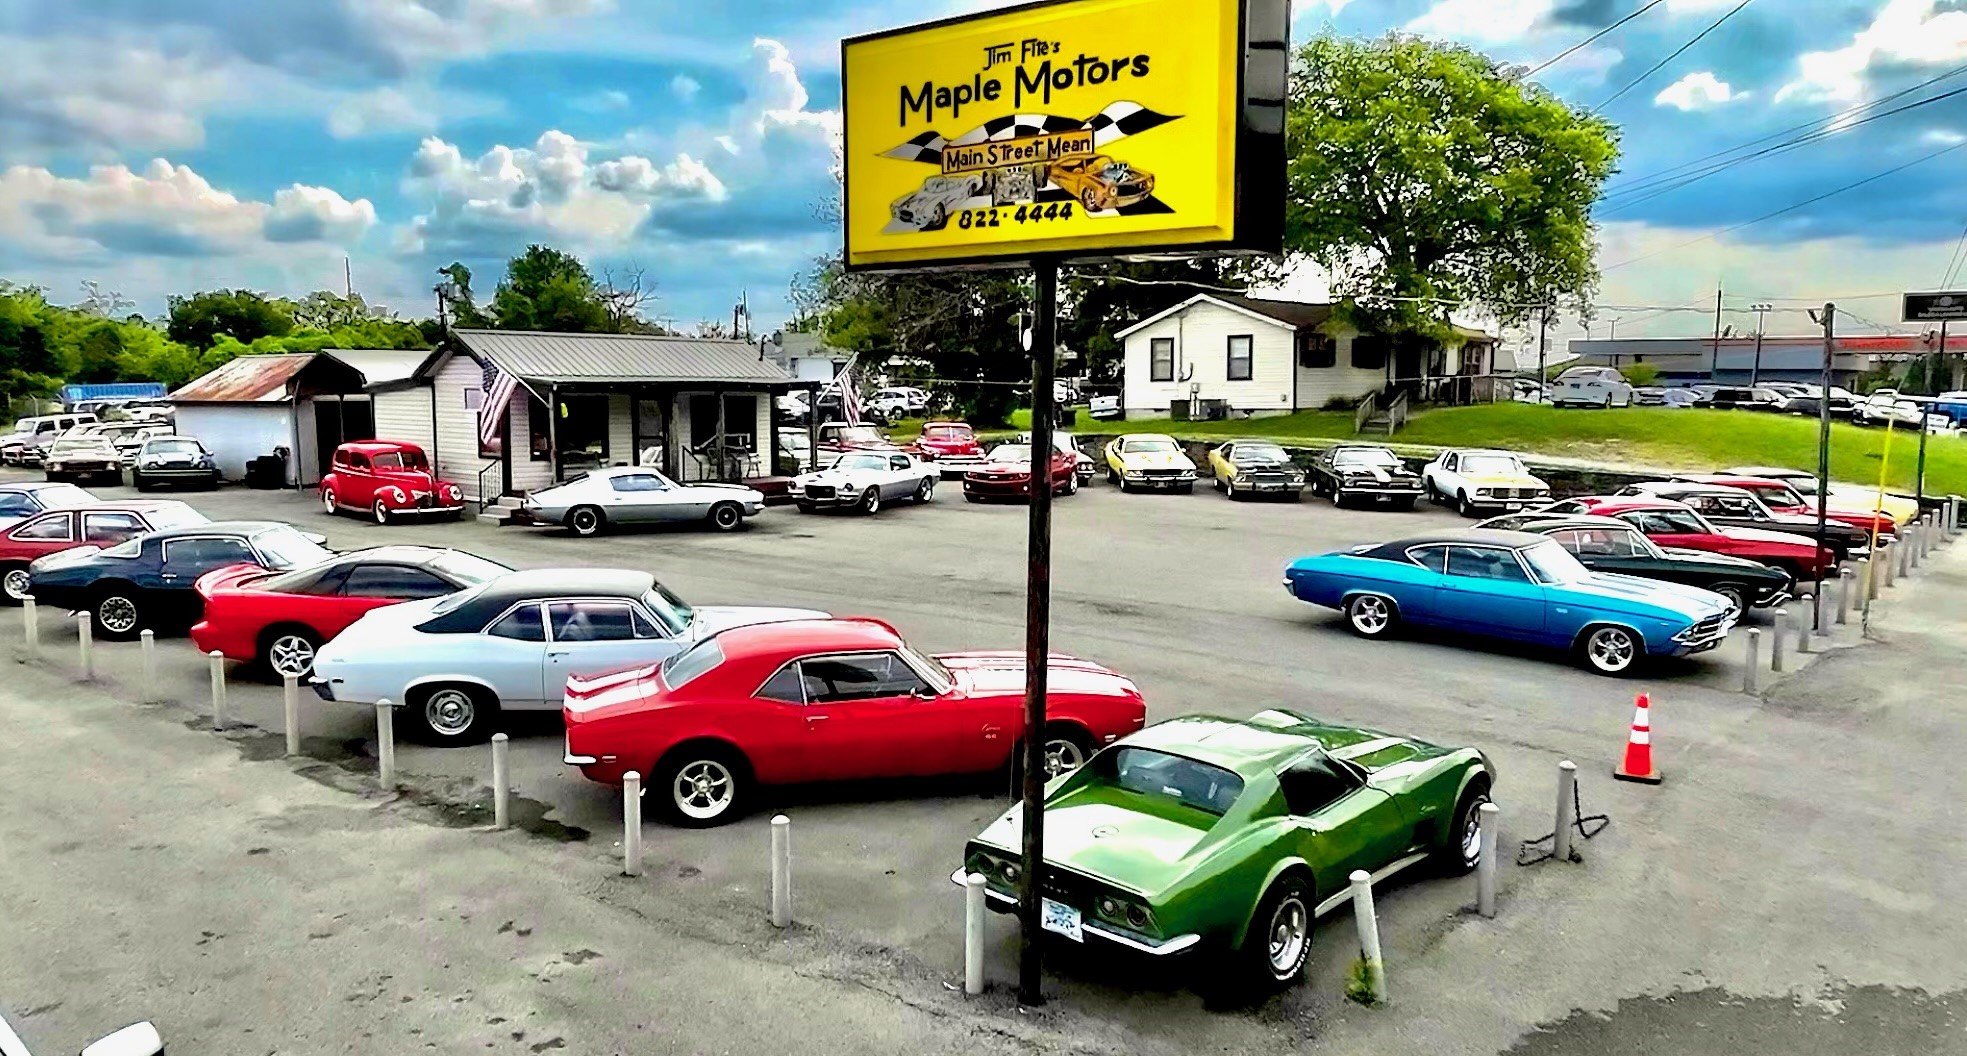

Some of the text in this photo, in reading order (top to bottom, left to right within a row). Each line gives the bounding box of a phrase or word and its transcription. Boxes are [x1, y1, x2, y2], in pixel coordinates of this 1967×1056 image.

[983, 42, 1015, 71] Jim
[900, 54, 1150, 127] Maple Motors
[946, 149, 984, 172] Main
[1047, 136, 1091, 159] Mean
